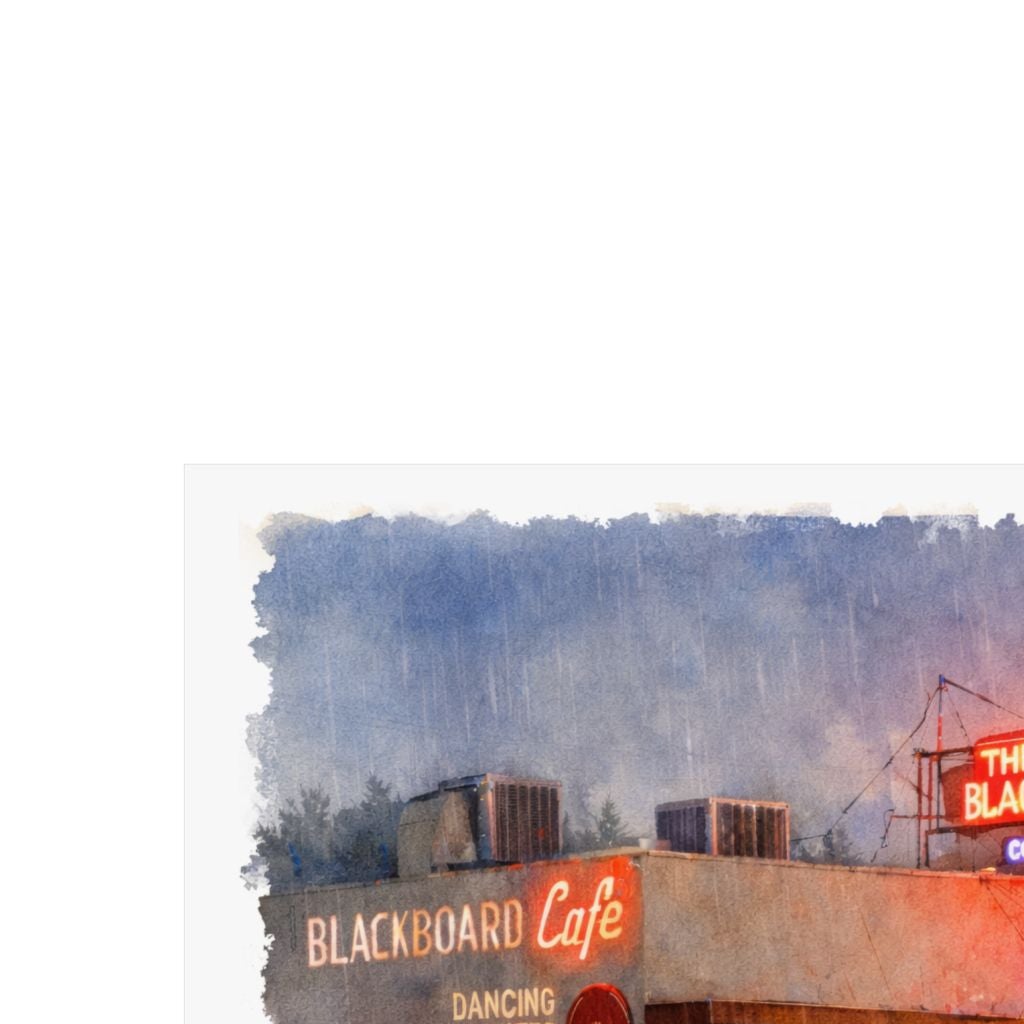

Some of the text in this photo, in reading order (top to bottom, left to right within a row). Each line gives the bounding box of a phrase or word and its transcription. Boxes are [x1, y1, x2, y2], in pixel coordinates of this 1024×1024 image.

[307, 876, 624, 967] BLACKBOARD Cafe
[452, 987, 556, 1021] DANCING
